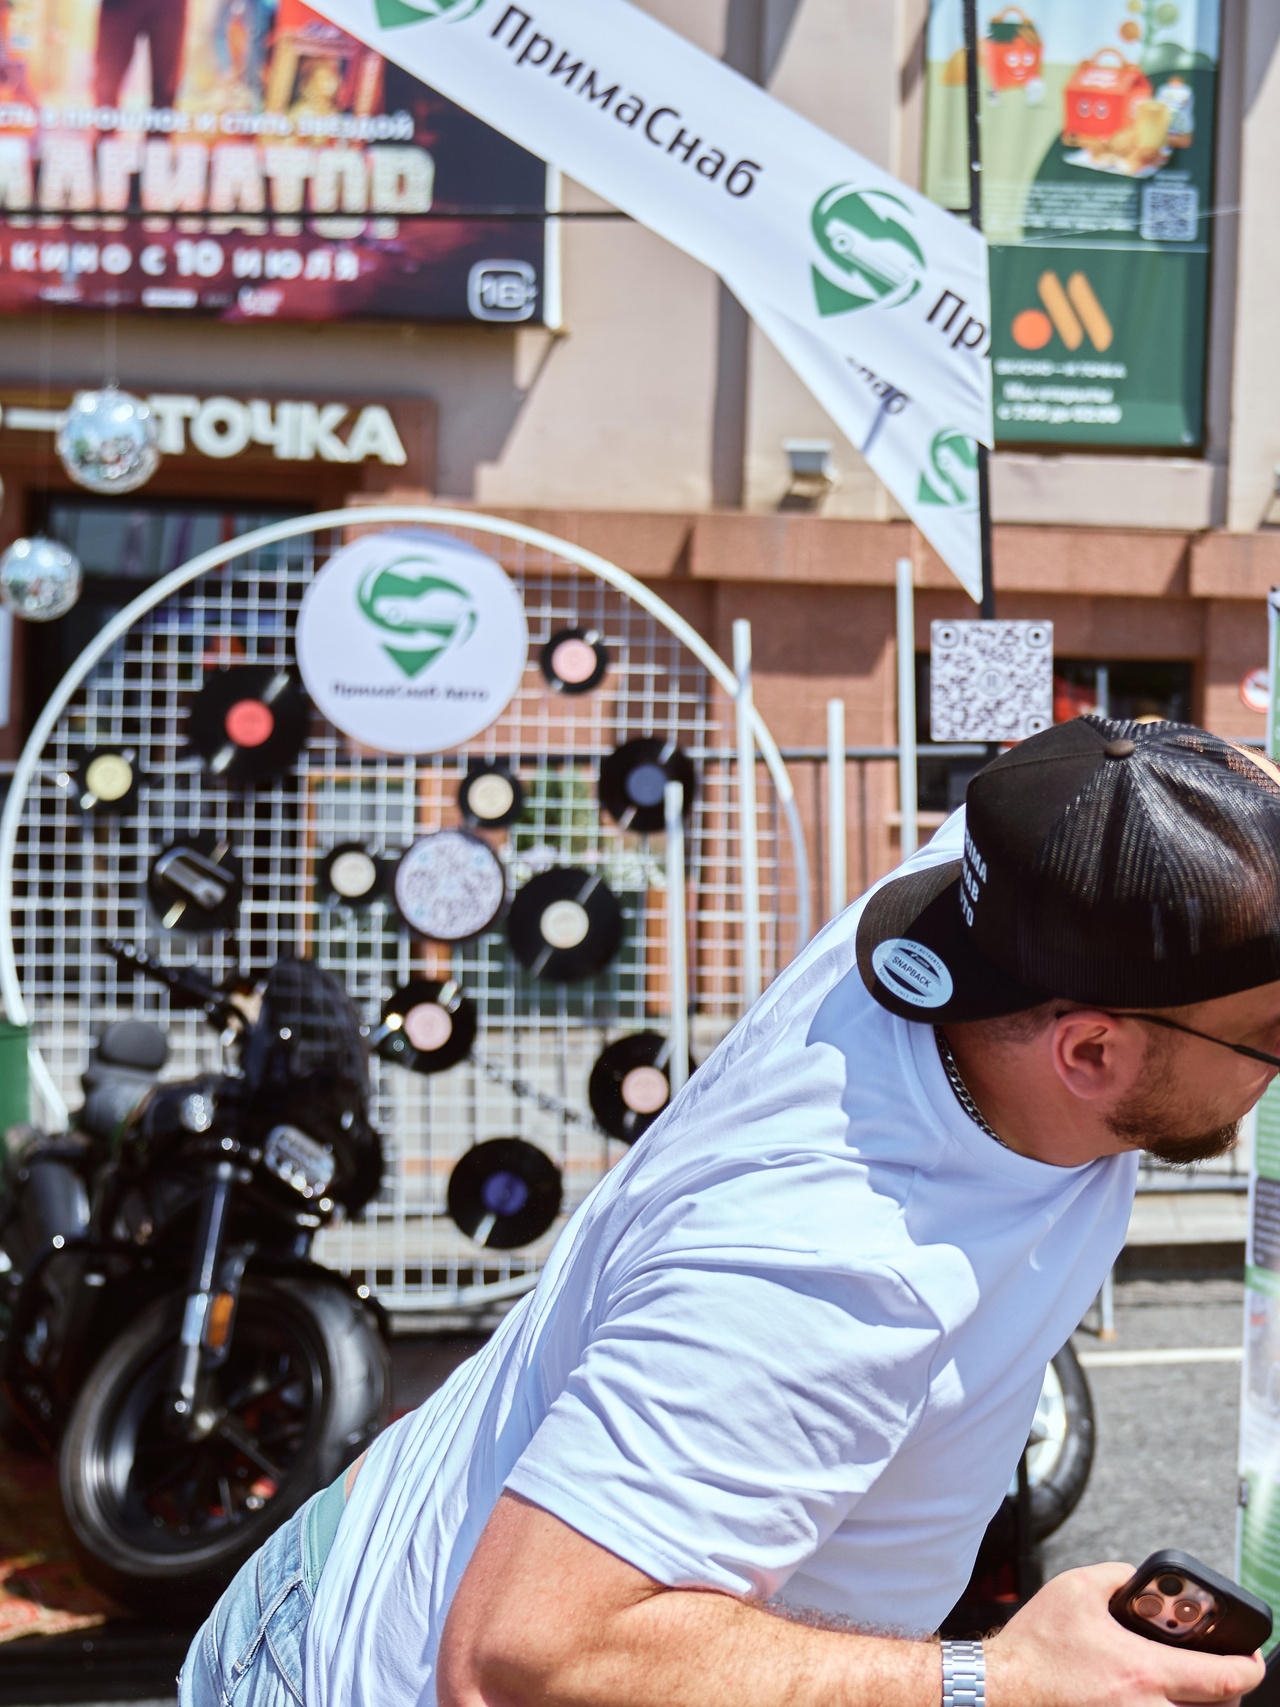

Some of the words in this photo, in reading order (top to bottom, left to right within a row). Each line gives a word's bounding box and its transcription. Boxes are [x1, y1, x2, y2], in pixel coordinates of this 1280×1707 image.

[489, 3, 763, 199] ПримаСнаб
[174, 238, 224, 278] 10
[150, 396, 407, 466] ТОЧКА
[891, 956, 932, 989] SNAPBACK
